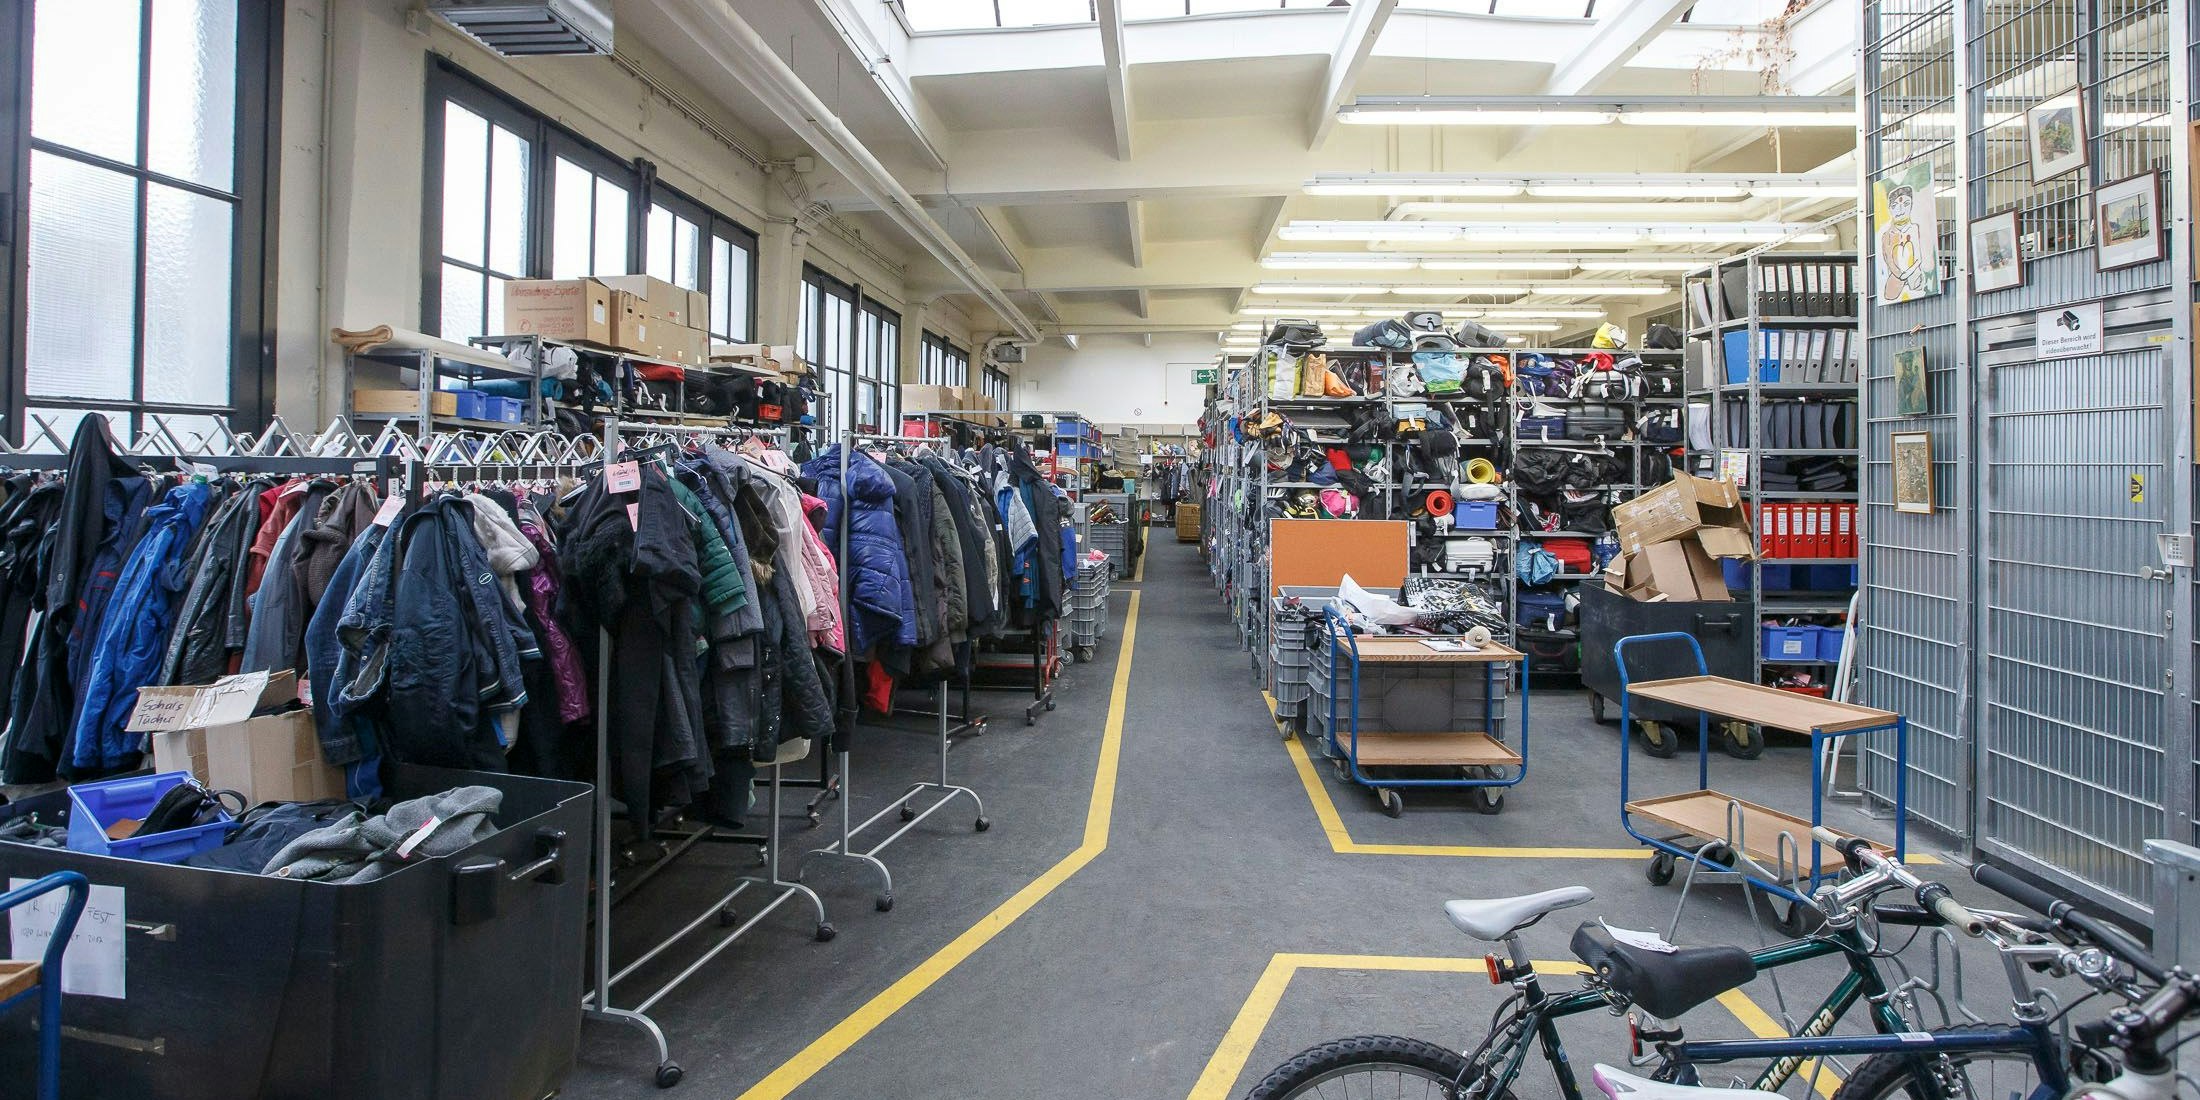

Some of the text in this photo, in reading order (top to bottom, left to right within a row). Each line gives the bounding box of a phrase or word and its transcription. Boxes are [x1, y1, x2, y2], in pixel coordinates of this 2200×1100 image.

[2041, 332, 2097, 346] Dieser Bereich wird
